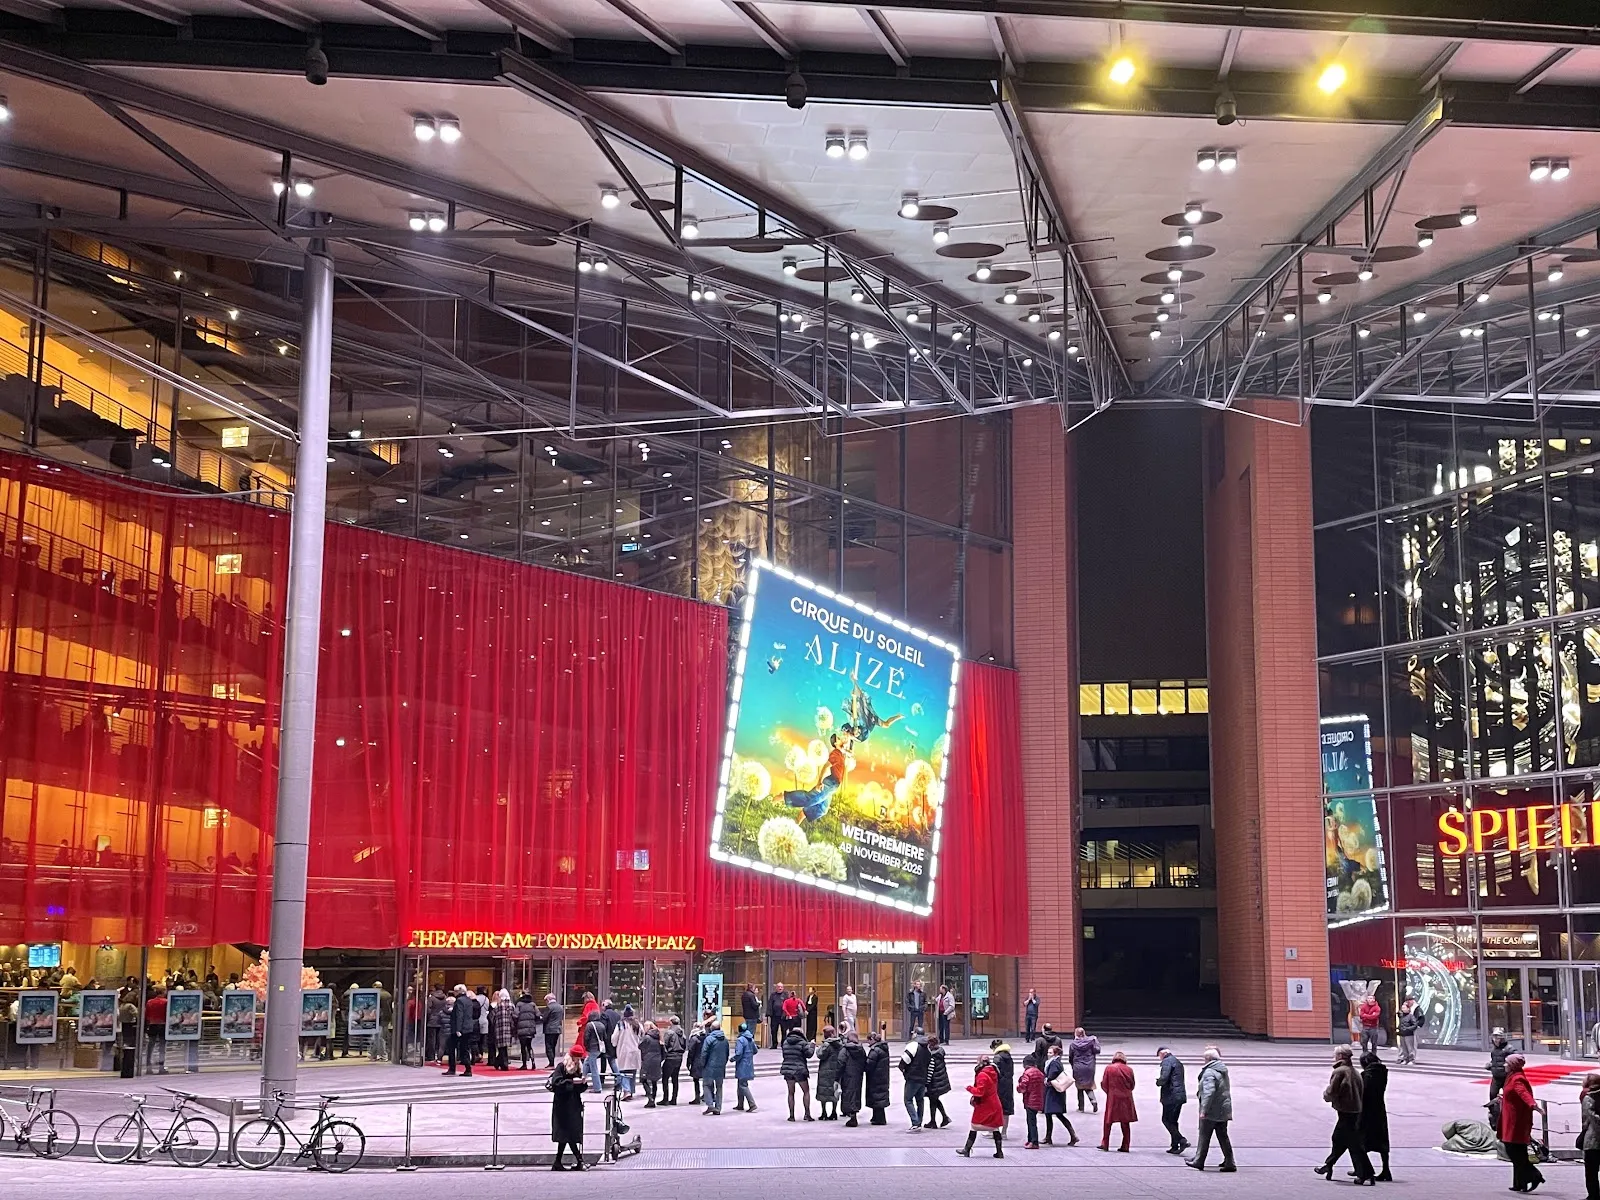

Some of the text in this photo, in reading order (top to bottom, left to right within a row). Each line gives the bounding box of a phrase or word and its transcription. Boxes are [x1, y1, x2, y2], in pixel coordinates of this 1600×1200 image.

[790, 596, 925, 668] CIRQUE DU SOLEIL
[841, 822, 925, 861] WELTPREMIERE
[1438, 801, 1600, 856] SPIEL
[839, 841, 923, 876] AB NOVEMBER 2025
[407, 930, 697, 950] THEATER AM POTSDAMER PLATZ
[1486, 936, 1501, 945] THE
